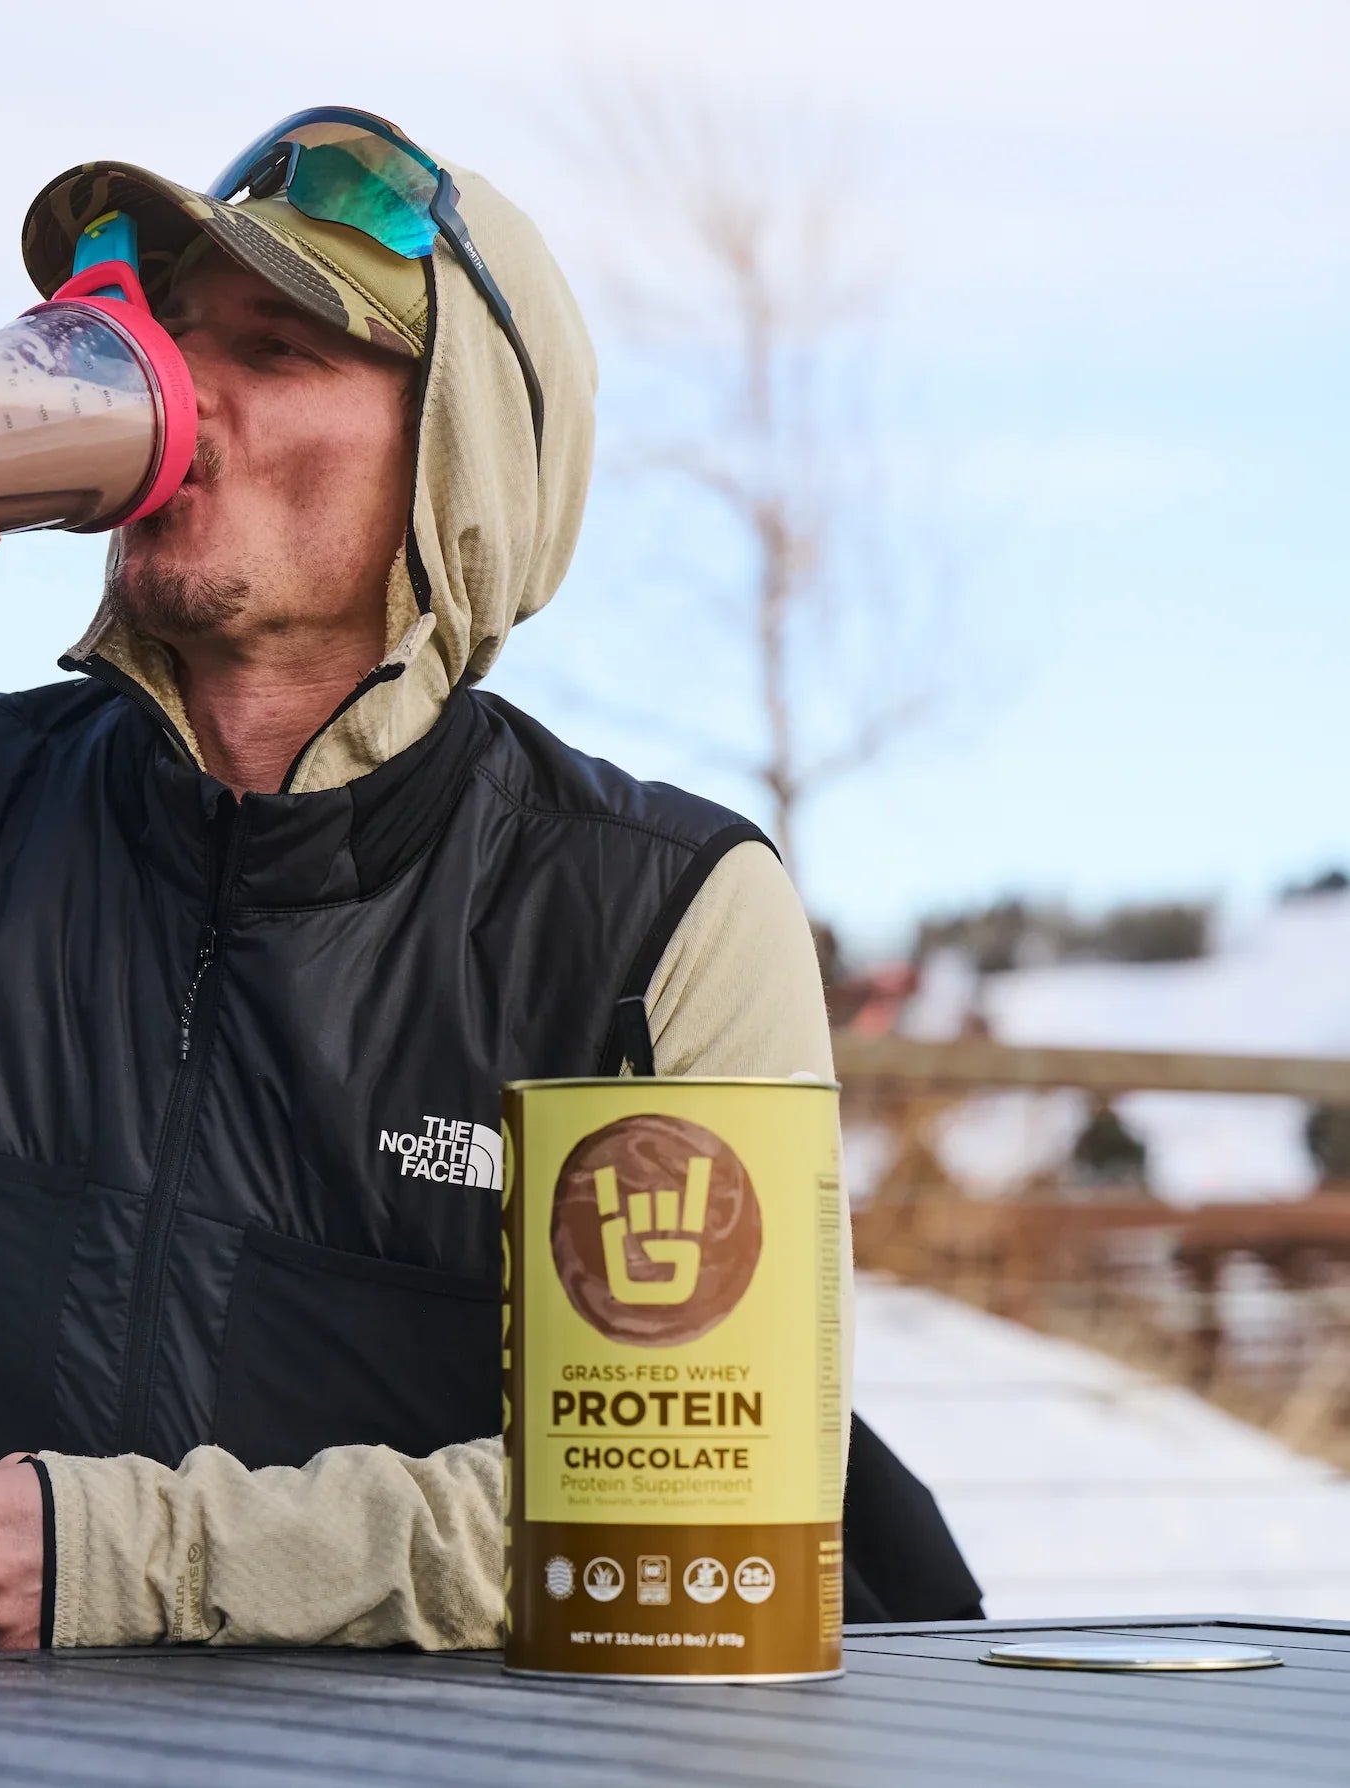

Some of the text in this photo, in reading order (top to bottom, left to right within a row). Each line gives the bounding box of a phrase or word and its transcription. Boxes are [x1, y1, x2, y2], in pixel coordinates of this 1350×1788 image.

[464, 241, 484, 270] SMITH
[422, 1115, 473, 1144] THE
[378, 1130, 469, 1164] NORTH
[400, 1154, 466, 1186] FACE
[561, 1365, 750, 1382] GRASS-FED WHEY
[552, 1390, 763, 1427] PROTEIN
[564, 1446, 750, 1470] CHOCOLATE
[560, 1474, 755, 1495] Protein Supplement
[570, 1631, 592, 1644] NET
[593, 1631, 614, 1645] WT
